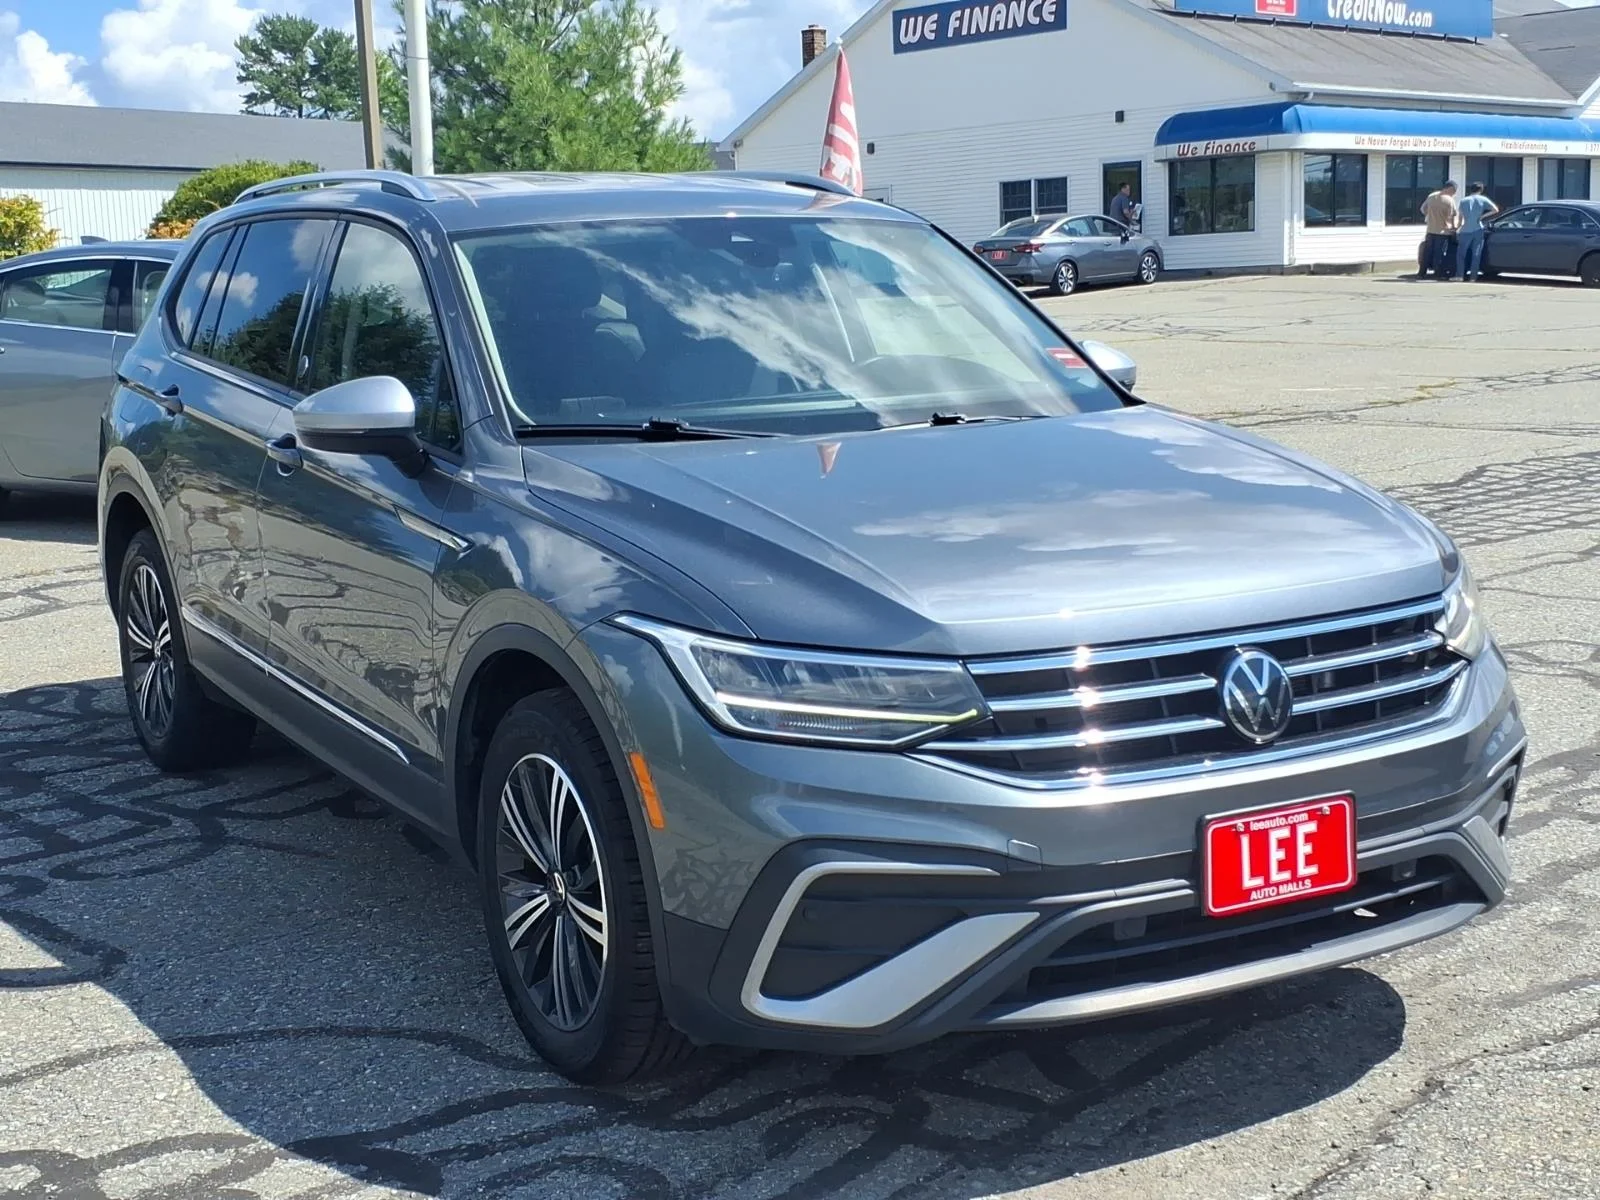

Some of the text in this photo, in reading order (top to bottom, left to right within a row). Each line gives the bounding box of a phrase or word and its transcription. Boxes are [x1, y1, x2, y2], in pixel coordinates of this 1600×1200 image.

[899, 0, 1057, 45] WE FINANCE
[1327, 0, 1433, 28] CreditNow.com
[1177, 141, 1256, 156] We Finance
[1354, 136, 1365, 145] We
[1367, 136, 1388, 146] Never
[1250, 813, 1308, 831] leeauto.com
[1241, 820, 1319, 890] LEE
[1250, 879, 1312, 900] AUTO MALLS
